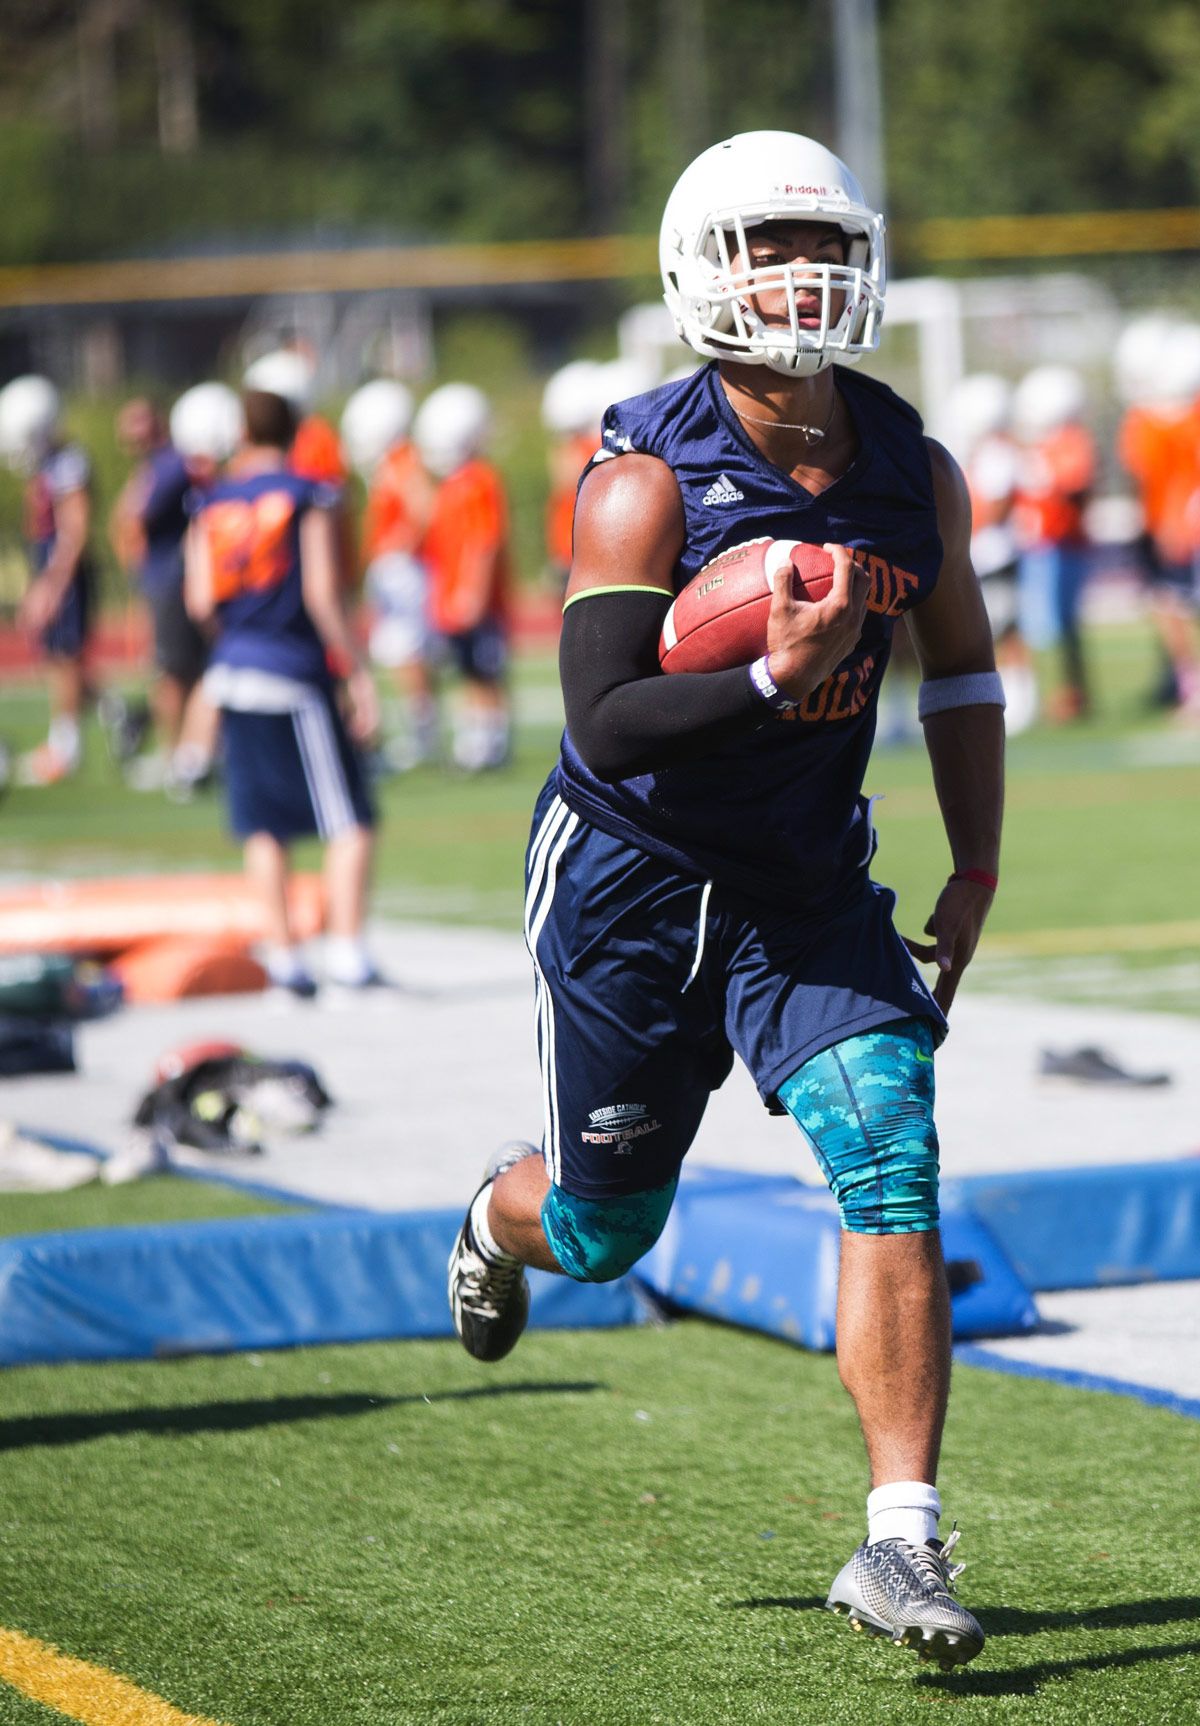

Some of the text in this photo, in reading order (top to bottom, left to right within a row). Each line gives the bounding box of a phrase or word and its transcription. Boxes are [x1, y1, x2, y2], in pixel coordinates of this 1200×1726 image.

[785, 184, 826, 196] Riddell
[702, 490, 745, 506] adidas
[581, 1119, 662, 1144] FOOTBALL
